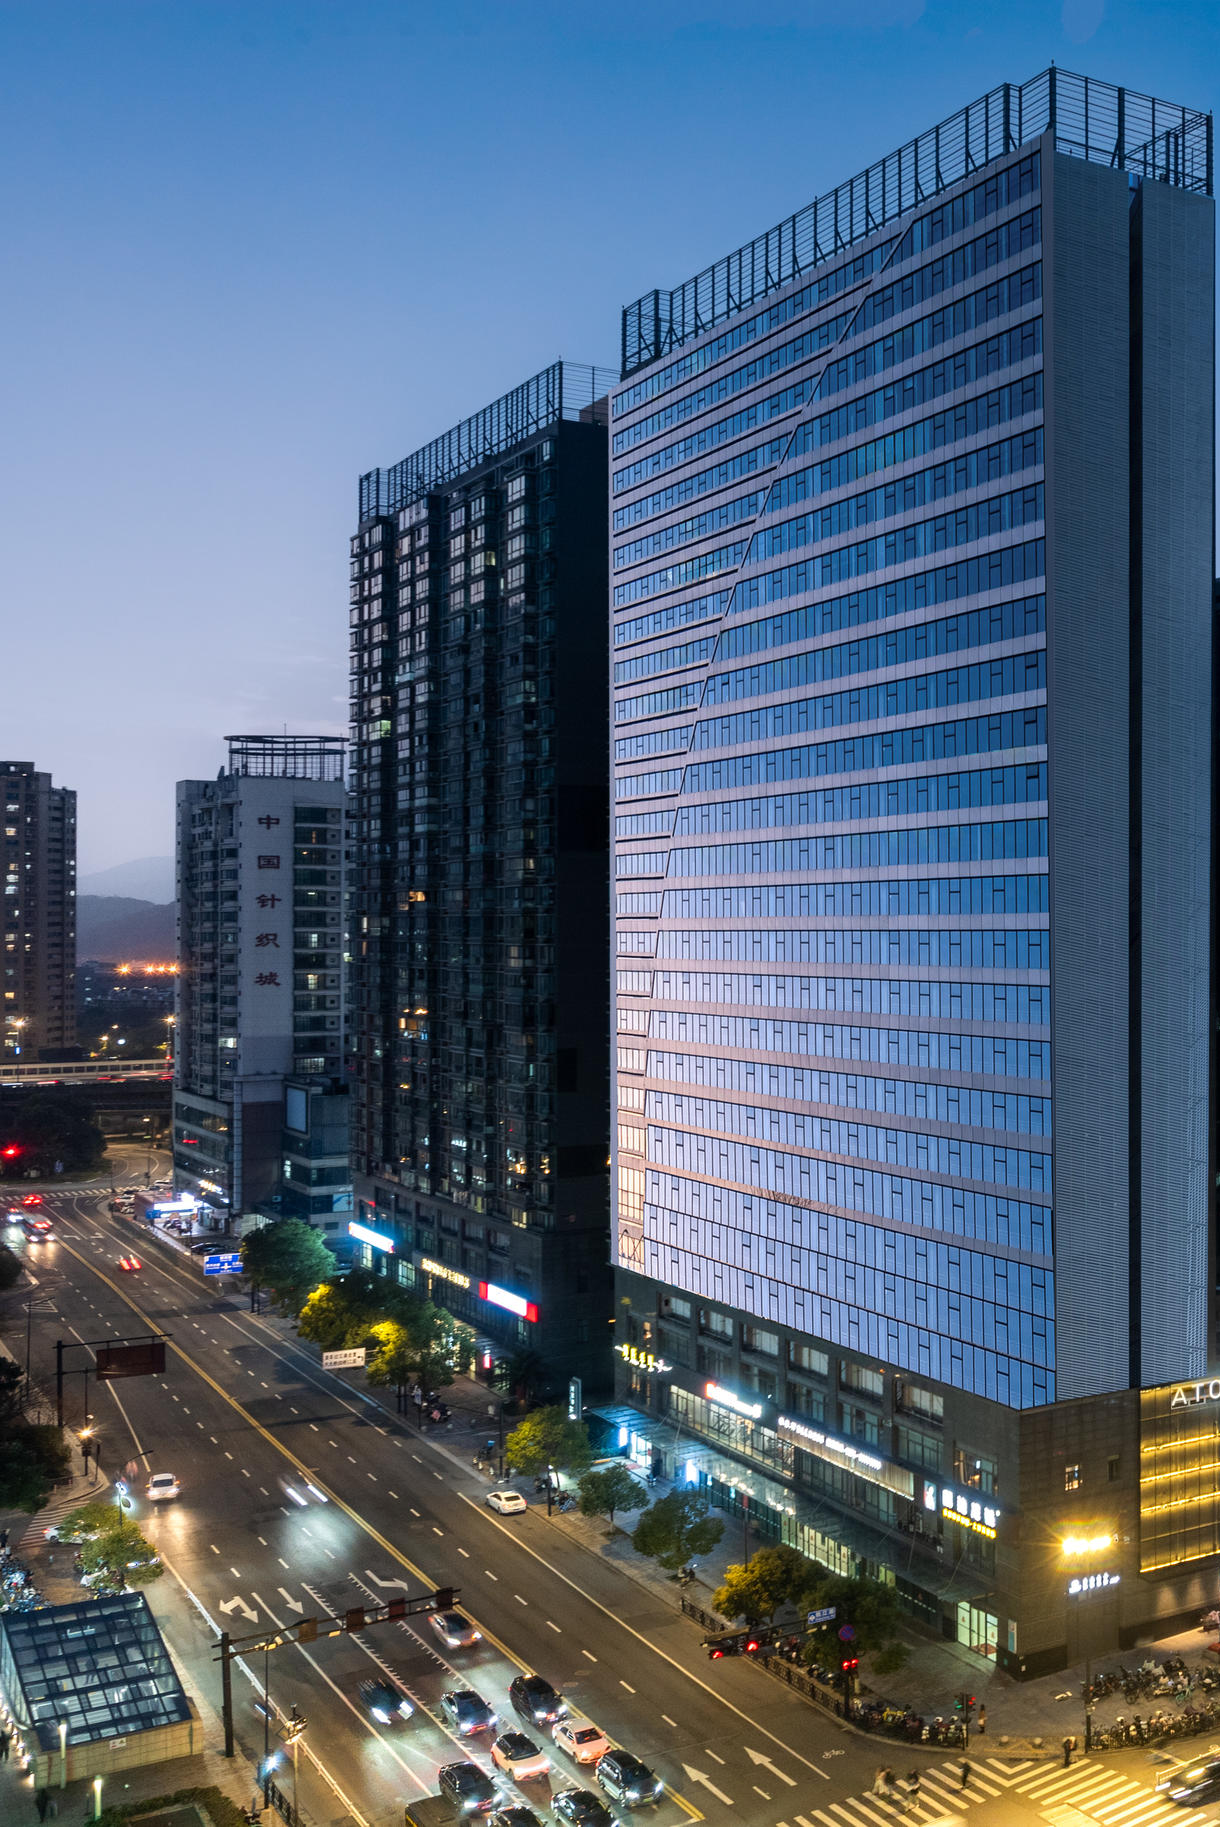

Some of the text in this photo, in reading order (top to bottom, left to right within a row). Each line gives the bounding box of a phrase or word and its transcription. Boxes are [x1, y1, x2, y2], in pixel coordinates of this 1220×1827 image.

[255, 814, 282, 987] 中国针织城
